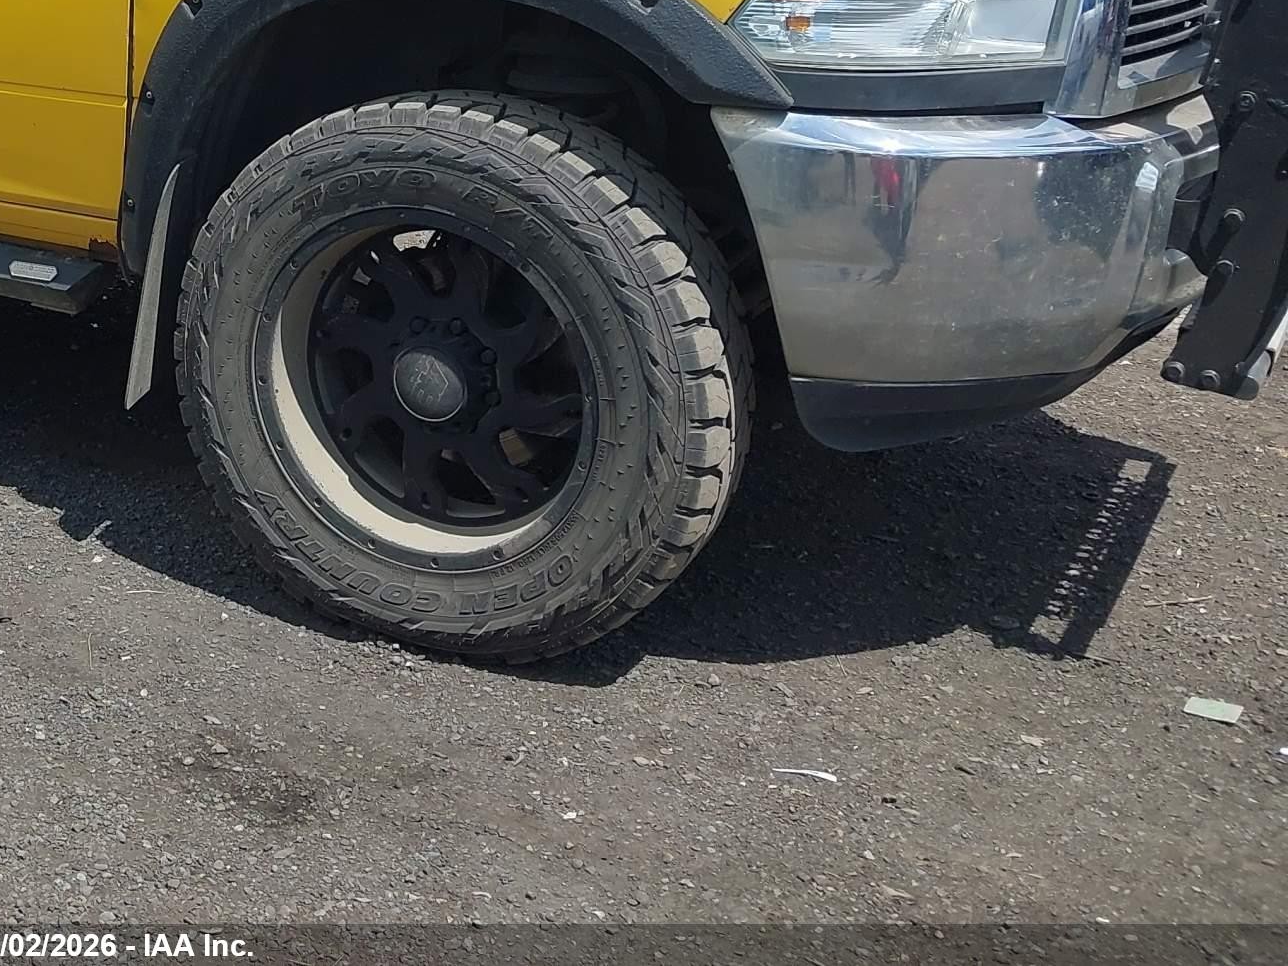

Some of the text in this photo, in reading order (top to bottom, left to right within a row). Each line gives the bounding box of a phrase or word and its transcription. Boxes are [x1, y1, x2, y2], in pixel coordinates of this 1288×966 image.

[290, 167, 438, 222] TOYO
[254, 489, 442, 613] COUNTRY
[458, 553, 574, 615] OPEN
